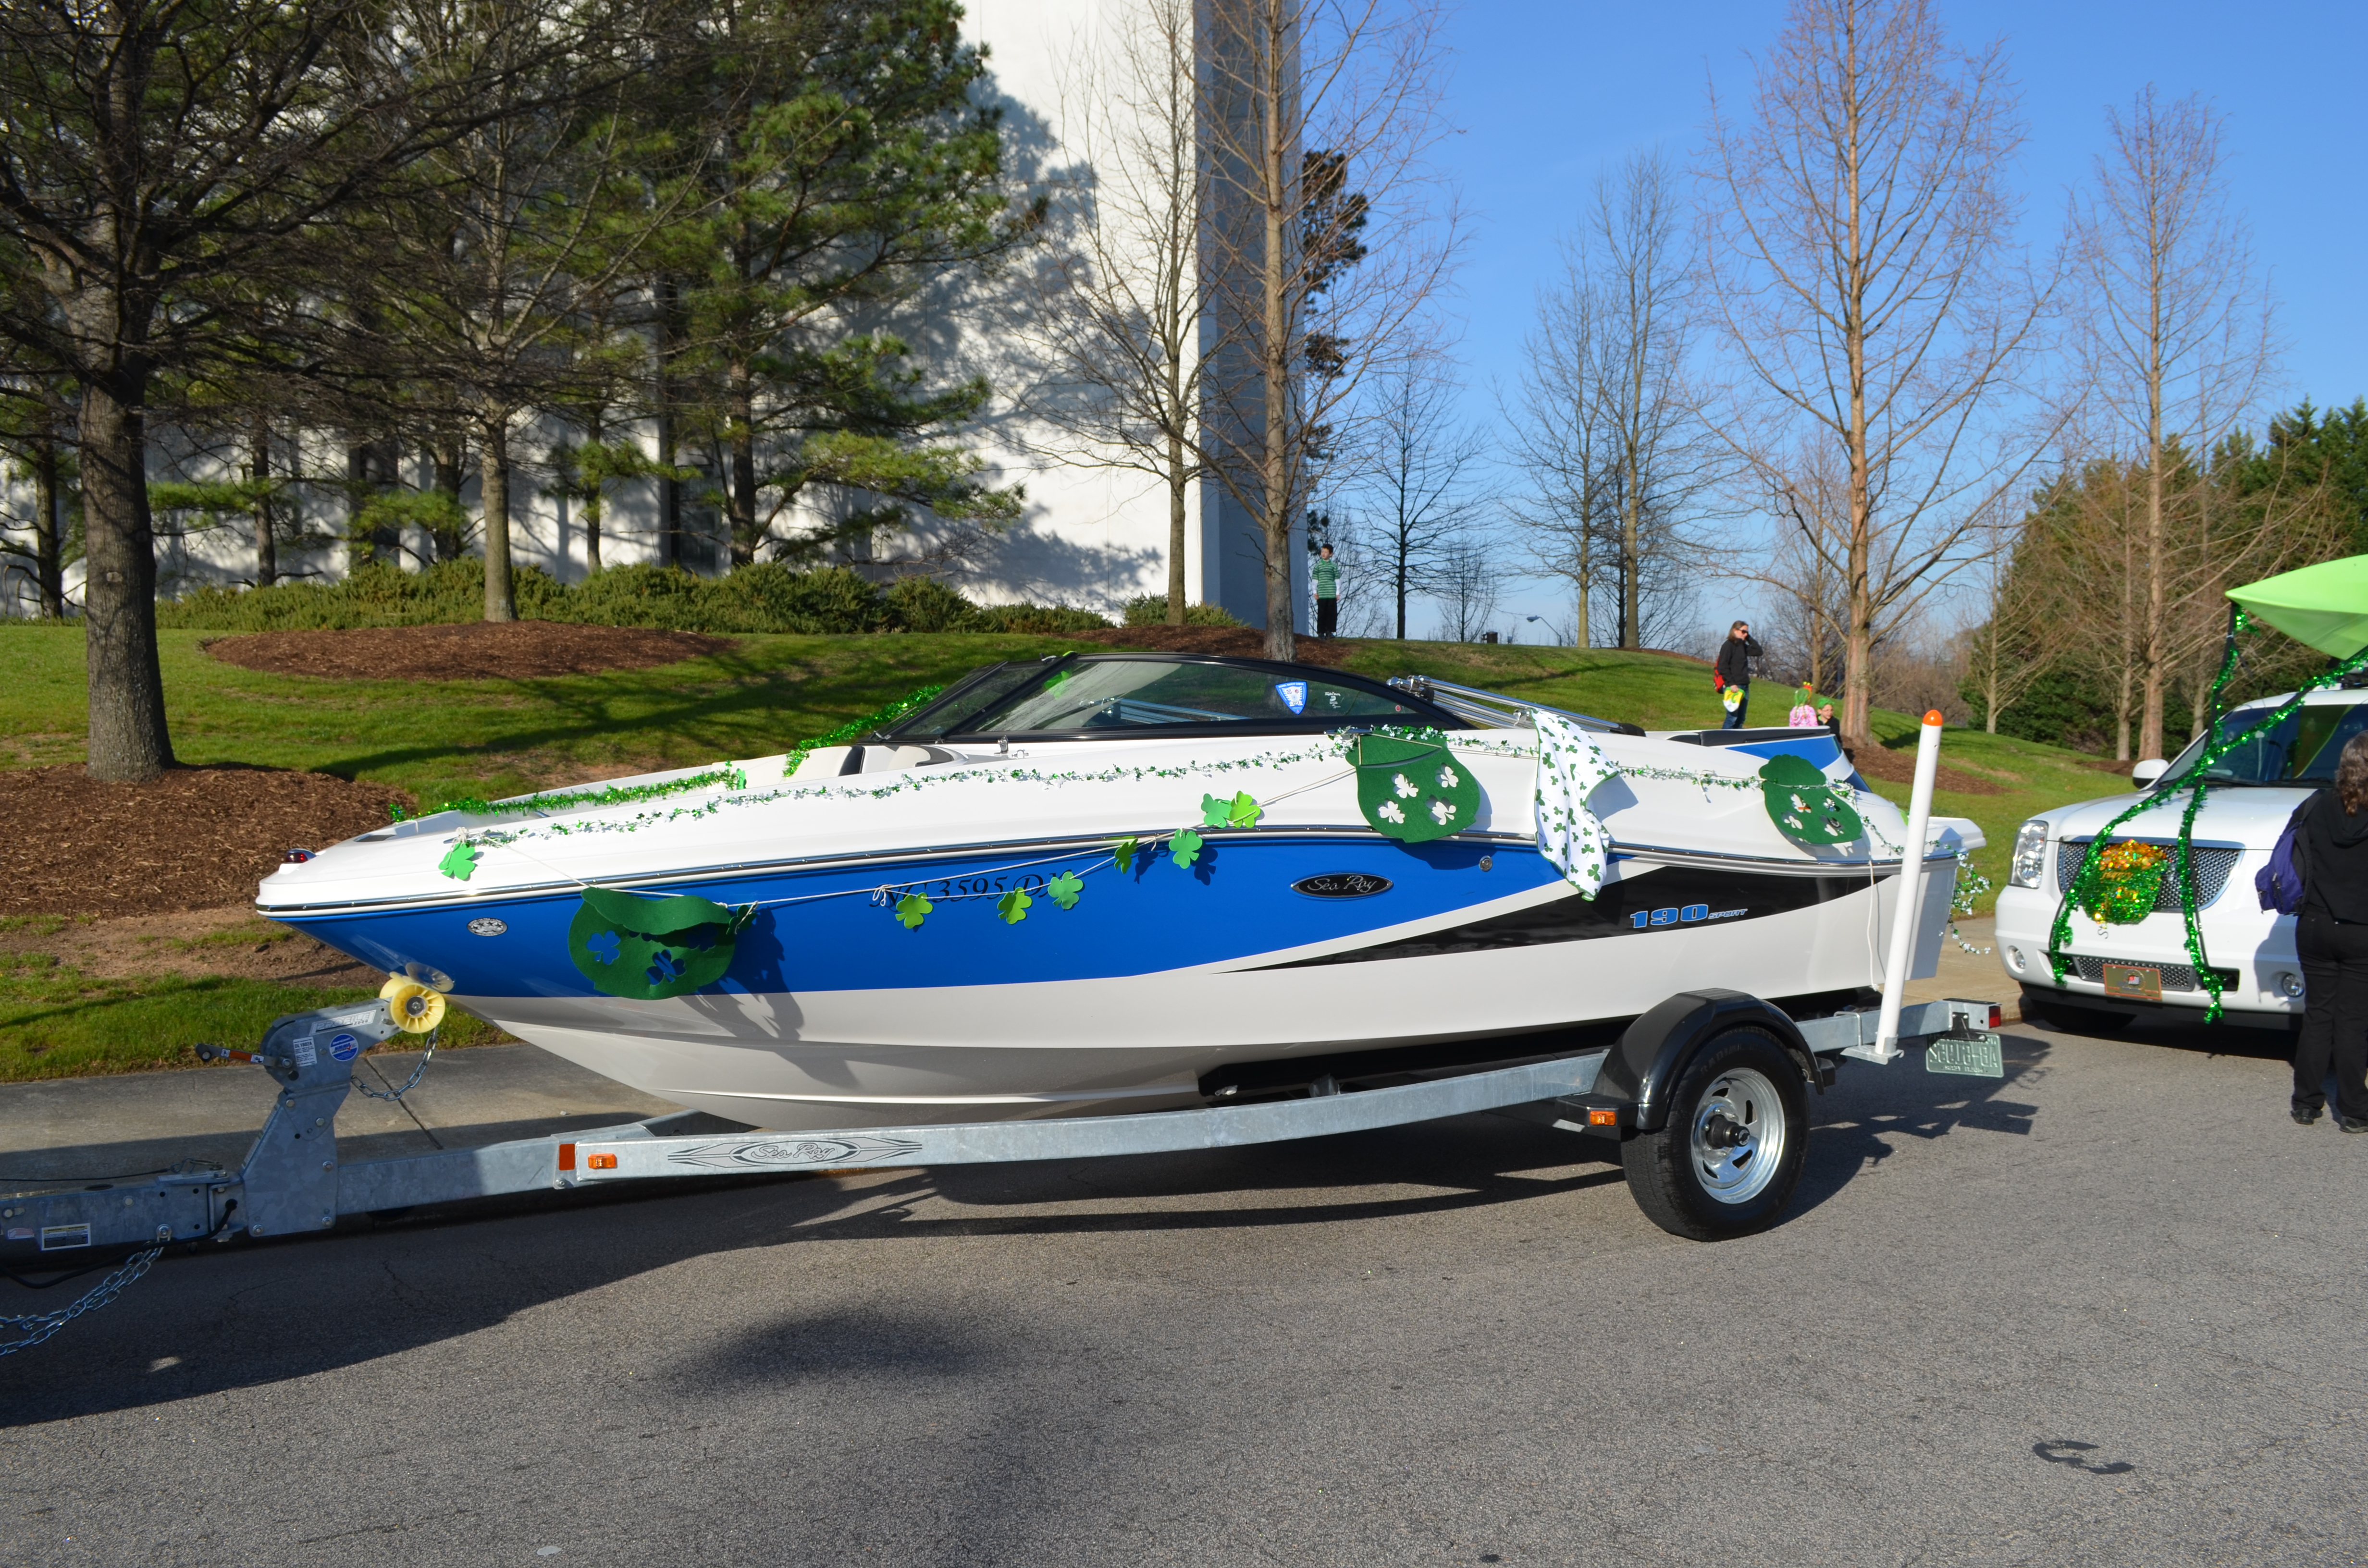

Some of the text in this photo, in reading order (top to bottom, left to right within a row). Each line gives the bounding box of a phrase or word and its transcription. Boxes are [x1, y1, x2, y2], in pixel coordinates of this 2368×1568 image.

[932, 875, 1008, 903] 3595
[1307, 875, 1377, 893] Sea Ray
[1630, 904, 1748, 928] 190 SPORT
[317, 1013, 370, 1030] PROFILE
[751, 1142, 835, 1161] Sea Ray
